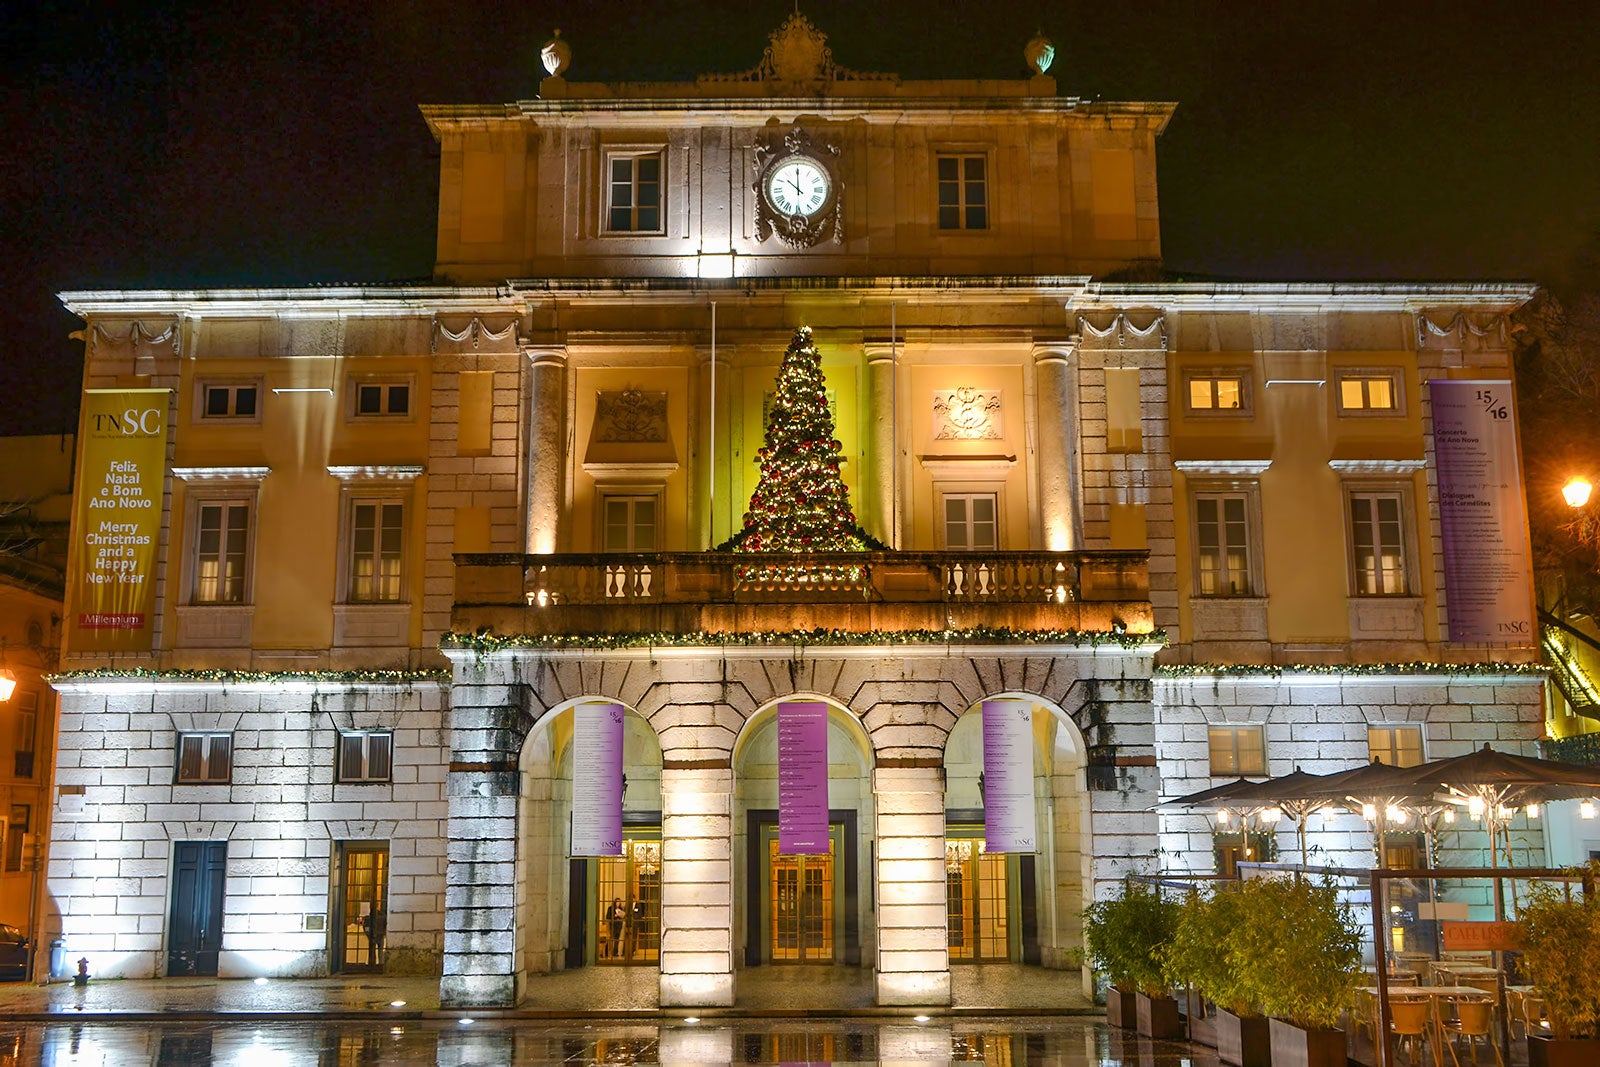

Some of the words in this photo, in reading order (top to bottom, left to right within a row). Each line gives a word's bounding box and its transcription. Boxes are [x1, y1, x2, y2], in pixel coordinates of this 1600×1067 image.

[93, 409, 161, 435] TNSC
[110, 461, 137, 472] Feliz
[105, 473, 140, 484] Natal
[101, 487, 109, 496] e
[113, 485, 142, 496] Bom
[1442, 492, 1475, 500] Dialogues
[89, 497, 116, 509] Ano
[119, 497, 152, 508] Novo
[100, 521, 138, 535] Merry
[86, 533, 150, 545] Christmas
[99, 546, 124, 557] and
[126, 548, 135, 557] a
[95, 558, 137, 572] Happy
[86, 572, 114, 584] New
[117, 572, 144, 583] Year
[85, 614, 139, 624] Millennium
[1497, 621, 1529, 633] TNSC
